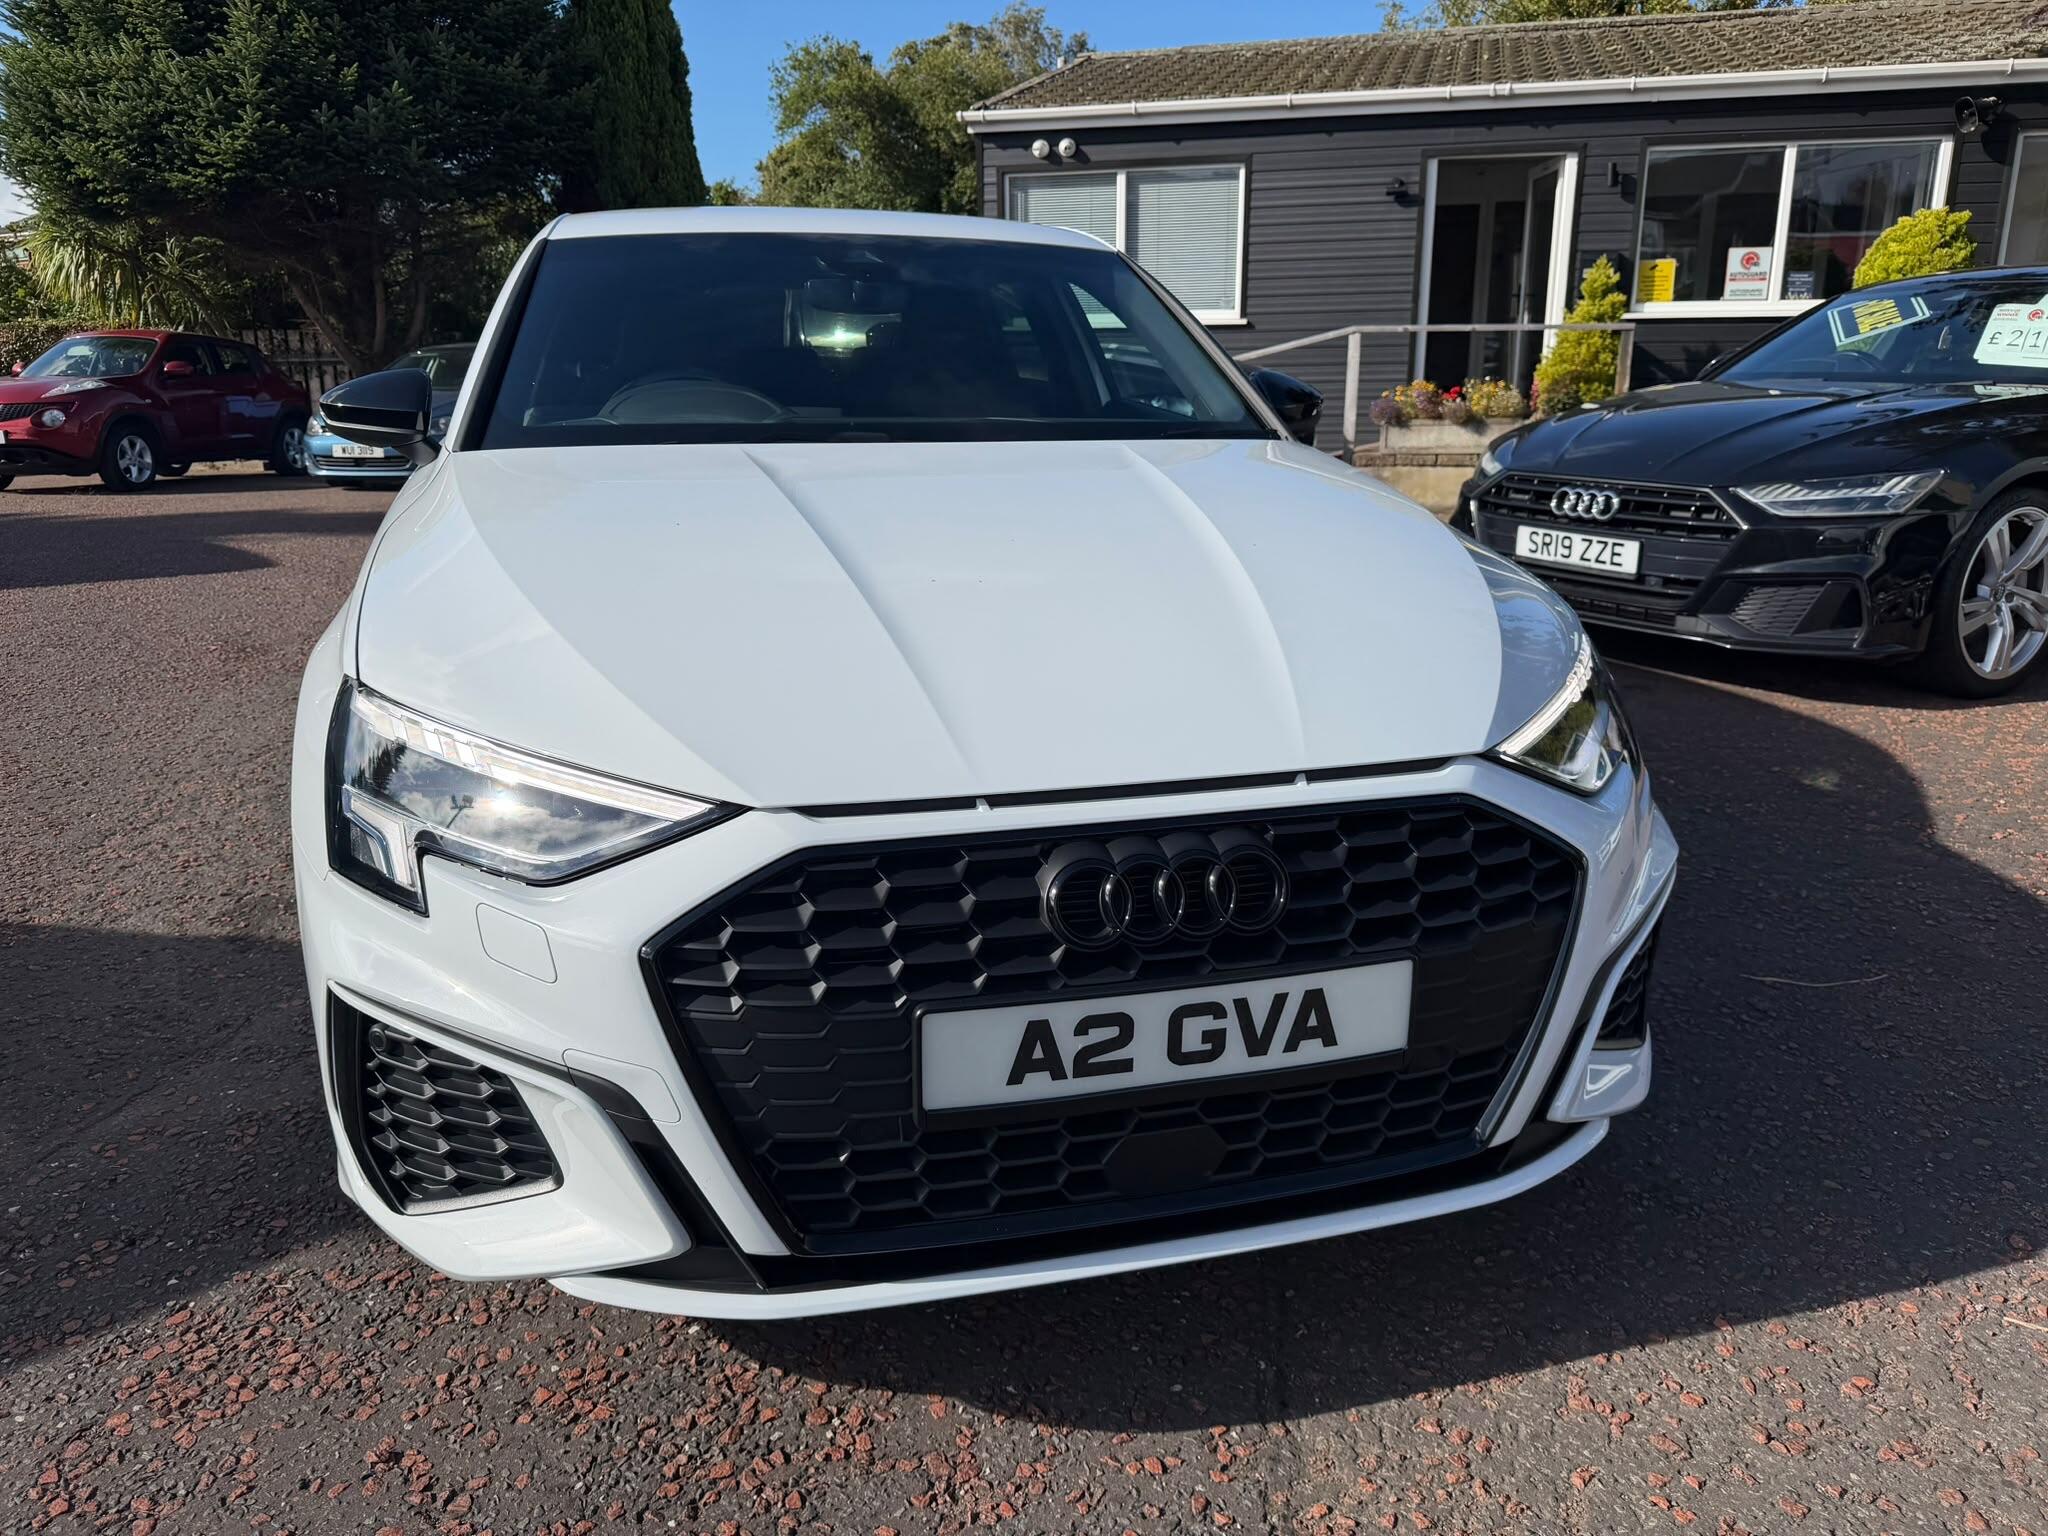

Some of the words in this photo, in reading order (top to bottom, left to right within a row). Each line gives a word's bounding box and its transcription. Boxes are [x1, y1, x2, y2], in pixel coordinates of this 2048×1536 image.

[1528, 531, 1573, 559] SR19
[1579, 538, 1625, 567] ZZE
[1006, 1011, 1135, 1086] A2
[1166, 987, 1339, 1066] GVA
